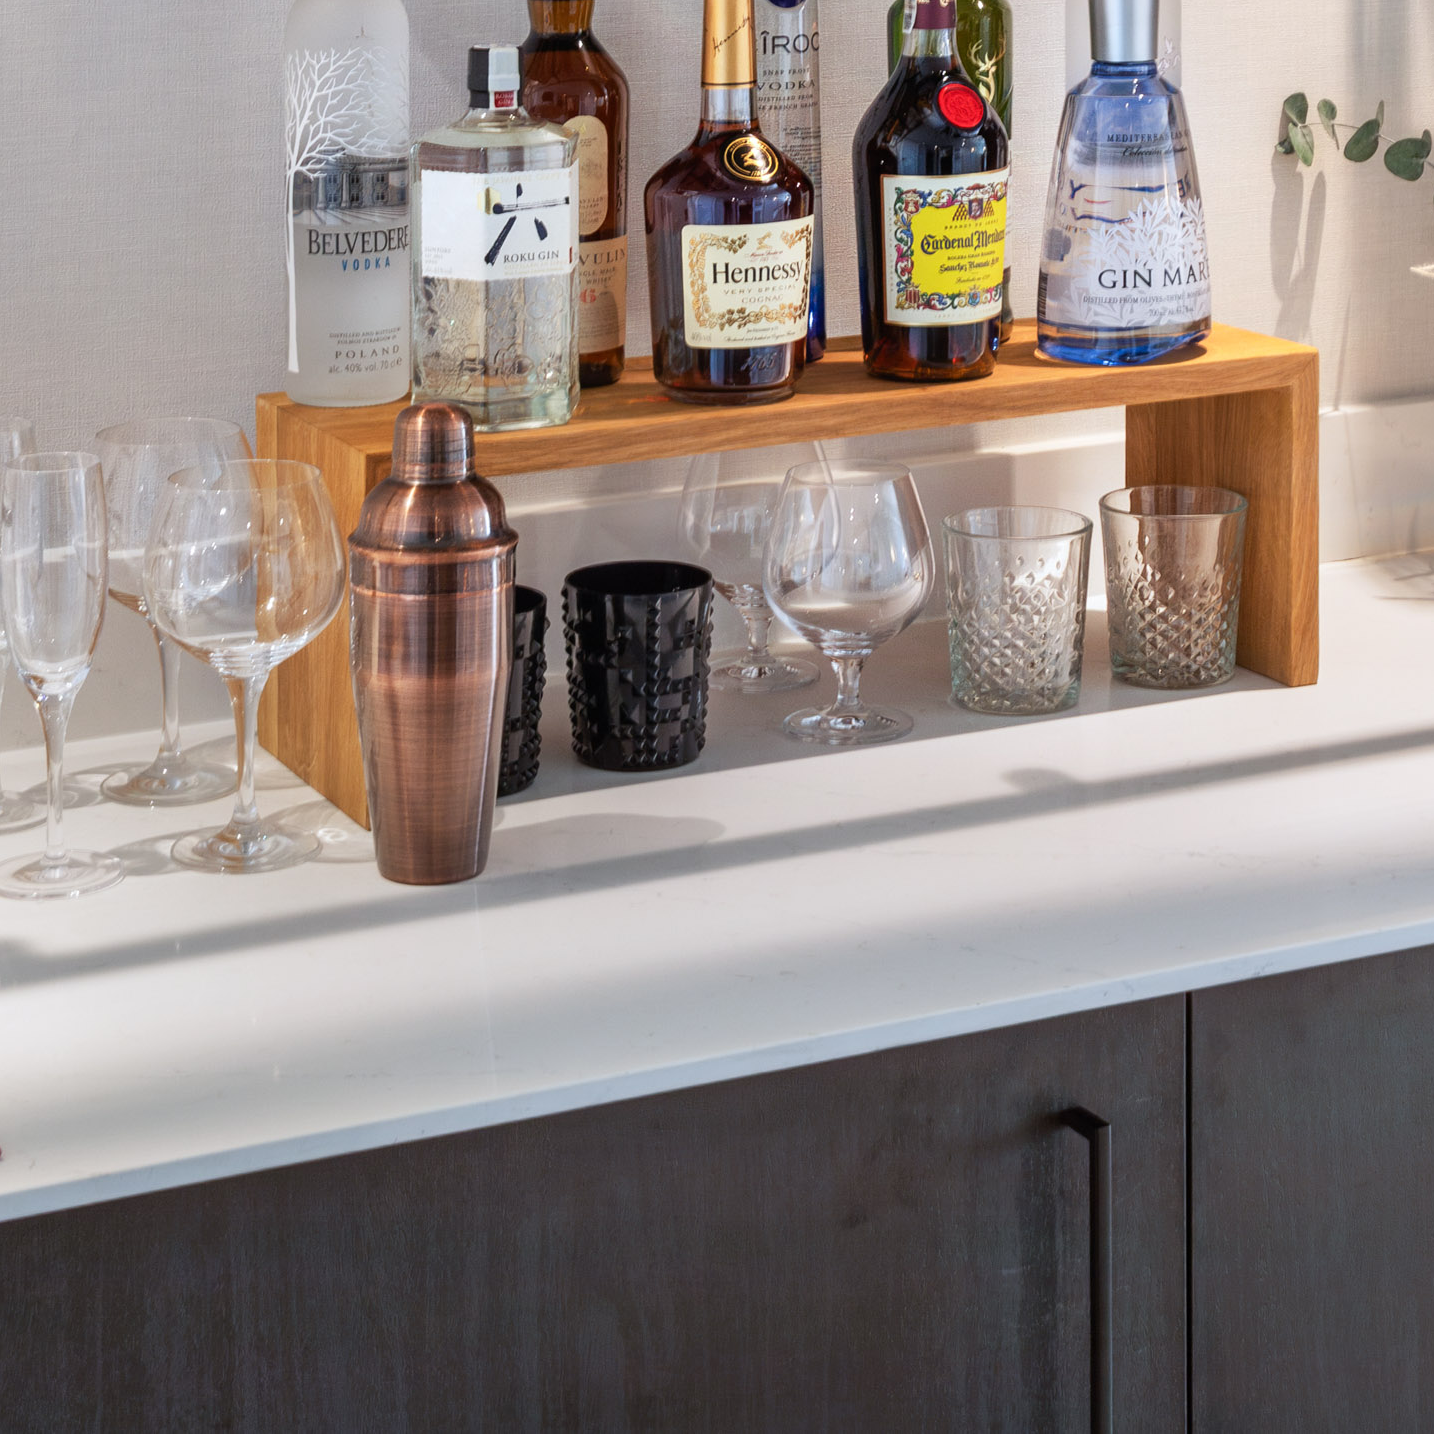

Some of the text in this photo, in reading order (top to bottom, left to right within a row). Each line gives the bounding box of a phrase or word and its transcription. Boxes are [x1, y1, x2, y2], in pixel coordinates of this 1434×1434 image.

[755, 30, 821, 56] ÎROC
[757, 78, 817, 92] VODKA
[306, 224, 410, 256] BELVEDERE
[920, 232, 975, 256] Cardenal
[341, 255, 391, 272] VODKA
[503, 249, 560, 265] ROKU GIN
[579, 248, 627, 267] VULIN
[712, 260, 804, 284] Hennessy
[1097, 268, 1153, 290] GIN
[723, 283, 797, 296] VERY SPECIAL
[741, 293, 784, 305] COGNAC
[1082, 295, 1118, 304] DISTILLED
[1118, 295, 1140, 305] FROM
[334, 344, 401, 359] POLAND
